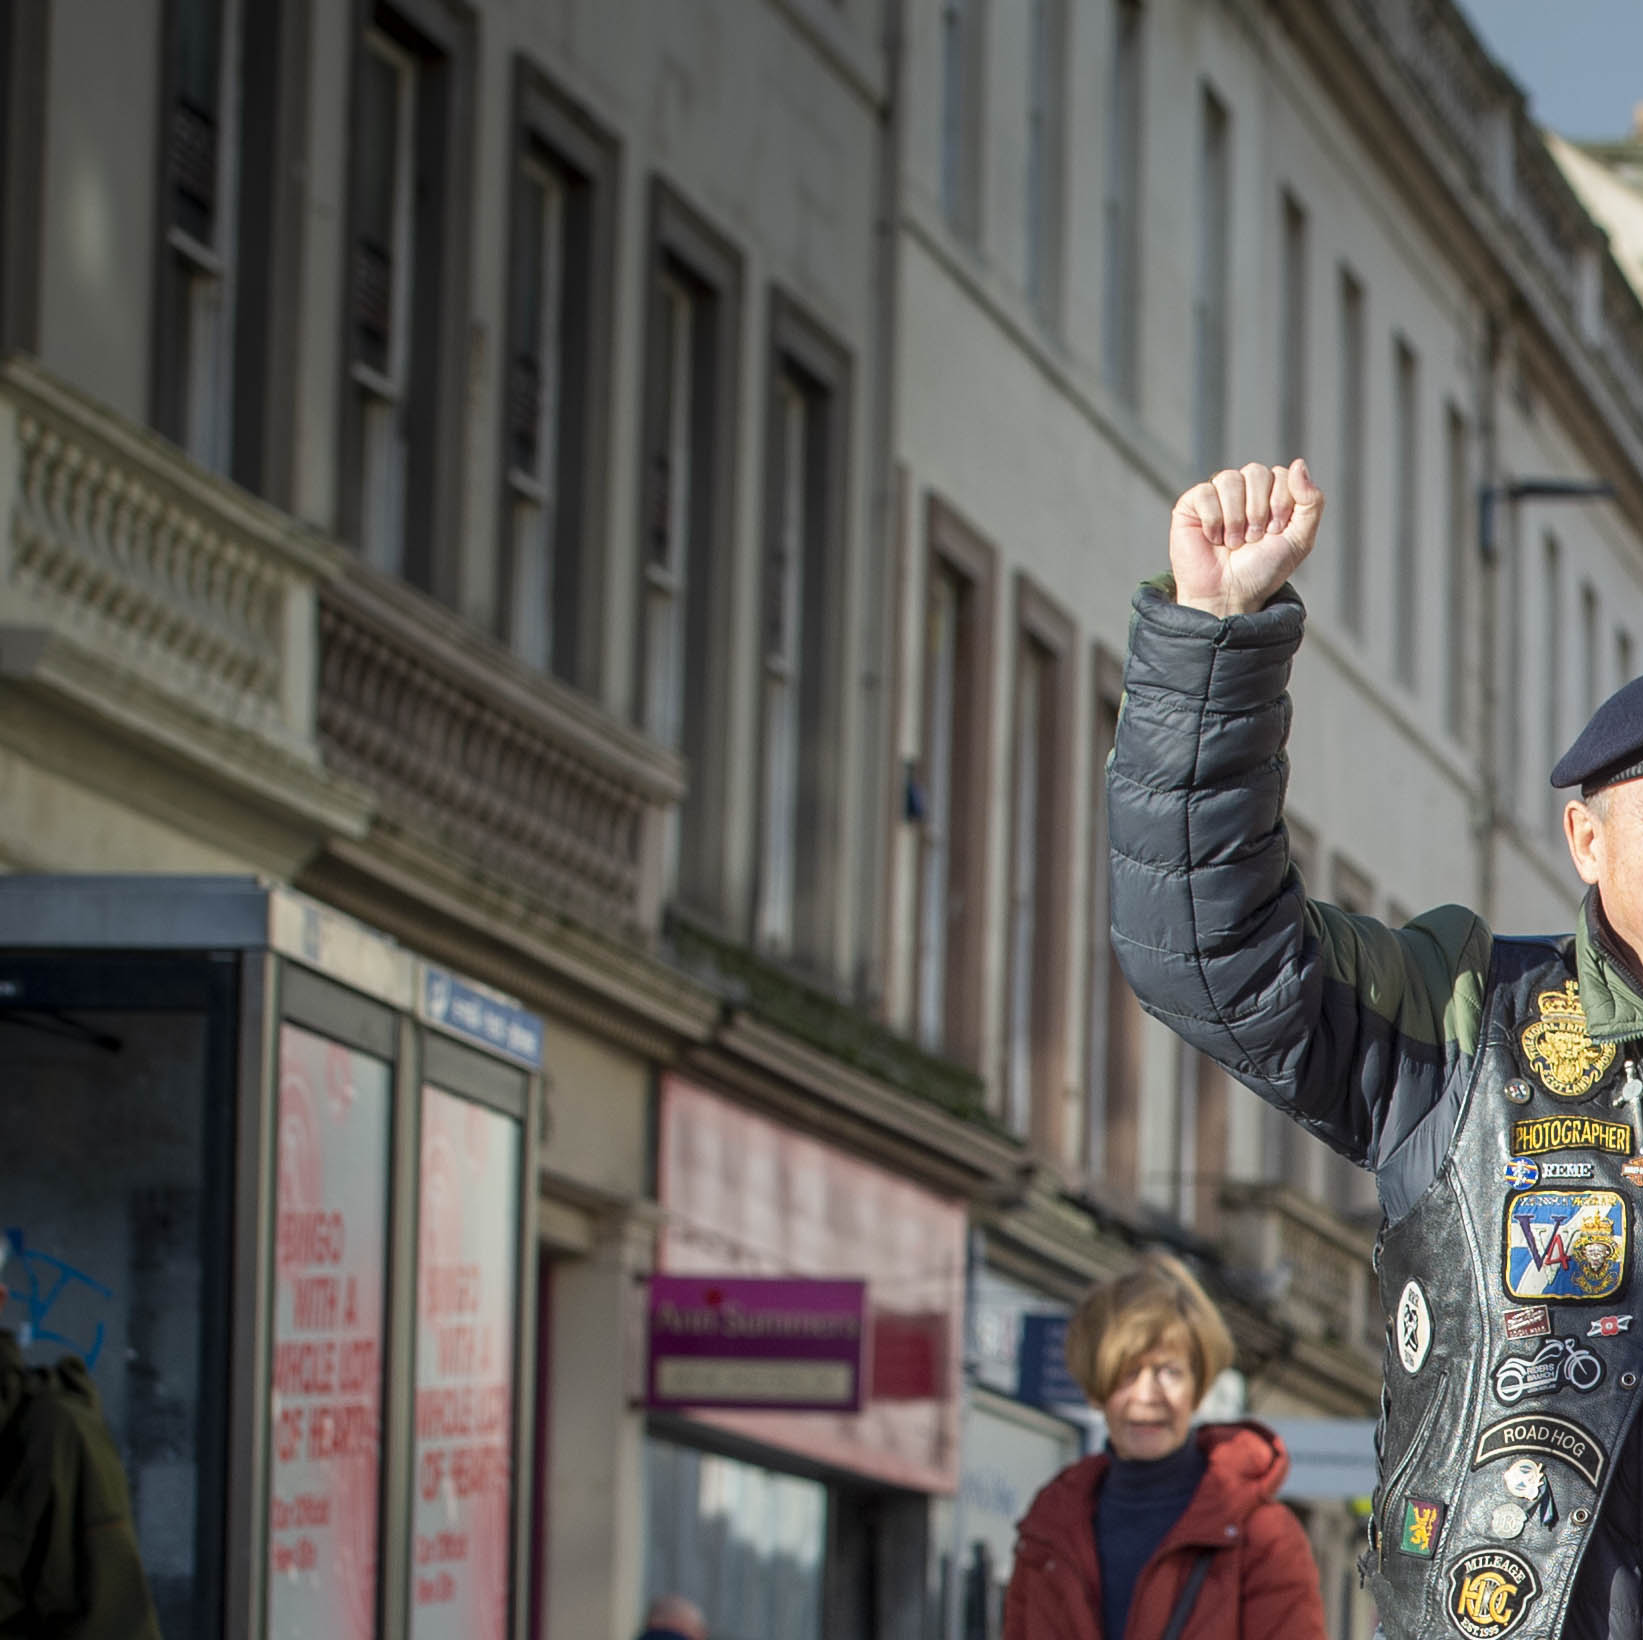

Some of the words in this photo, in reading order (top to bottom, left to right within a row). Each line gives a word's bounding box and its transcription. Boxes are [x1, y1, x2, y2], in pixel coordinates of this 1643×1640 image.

[1515, 1119, 1627, 1151] PHOTOGRAPHER
[1542, 1163, 1593, 1180] REME
[1503, 1425, 1550, 1444] ROAD
[1550, 1429, 1586, 1458] HOG
[1463, 1555, 1526, 1584] MILEAGE
